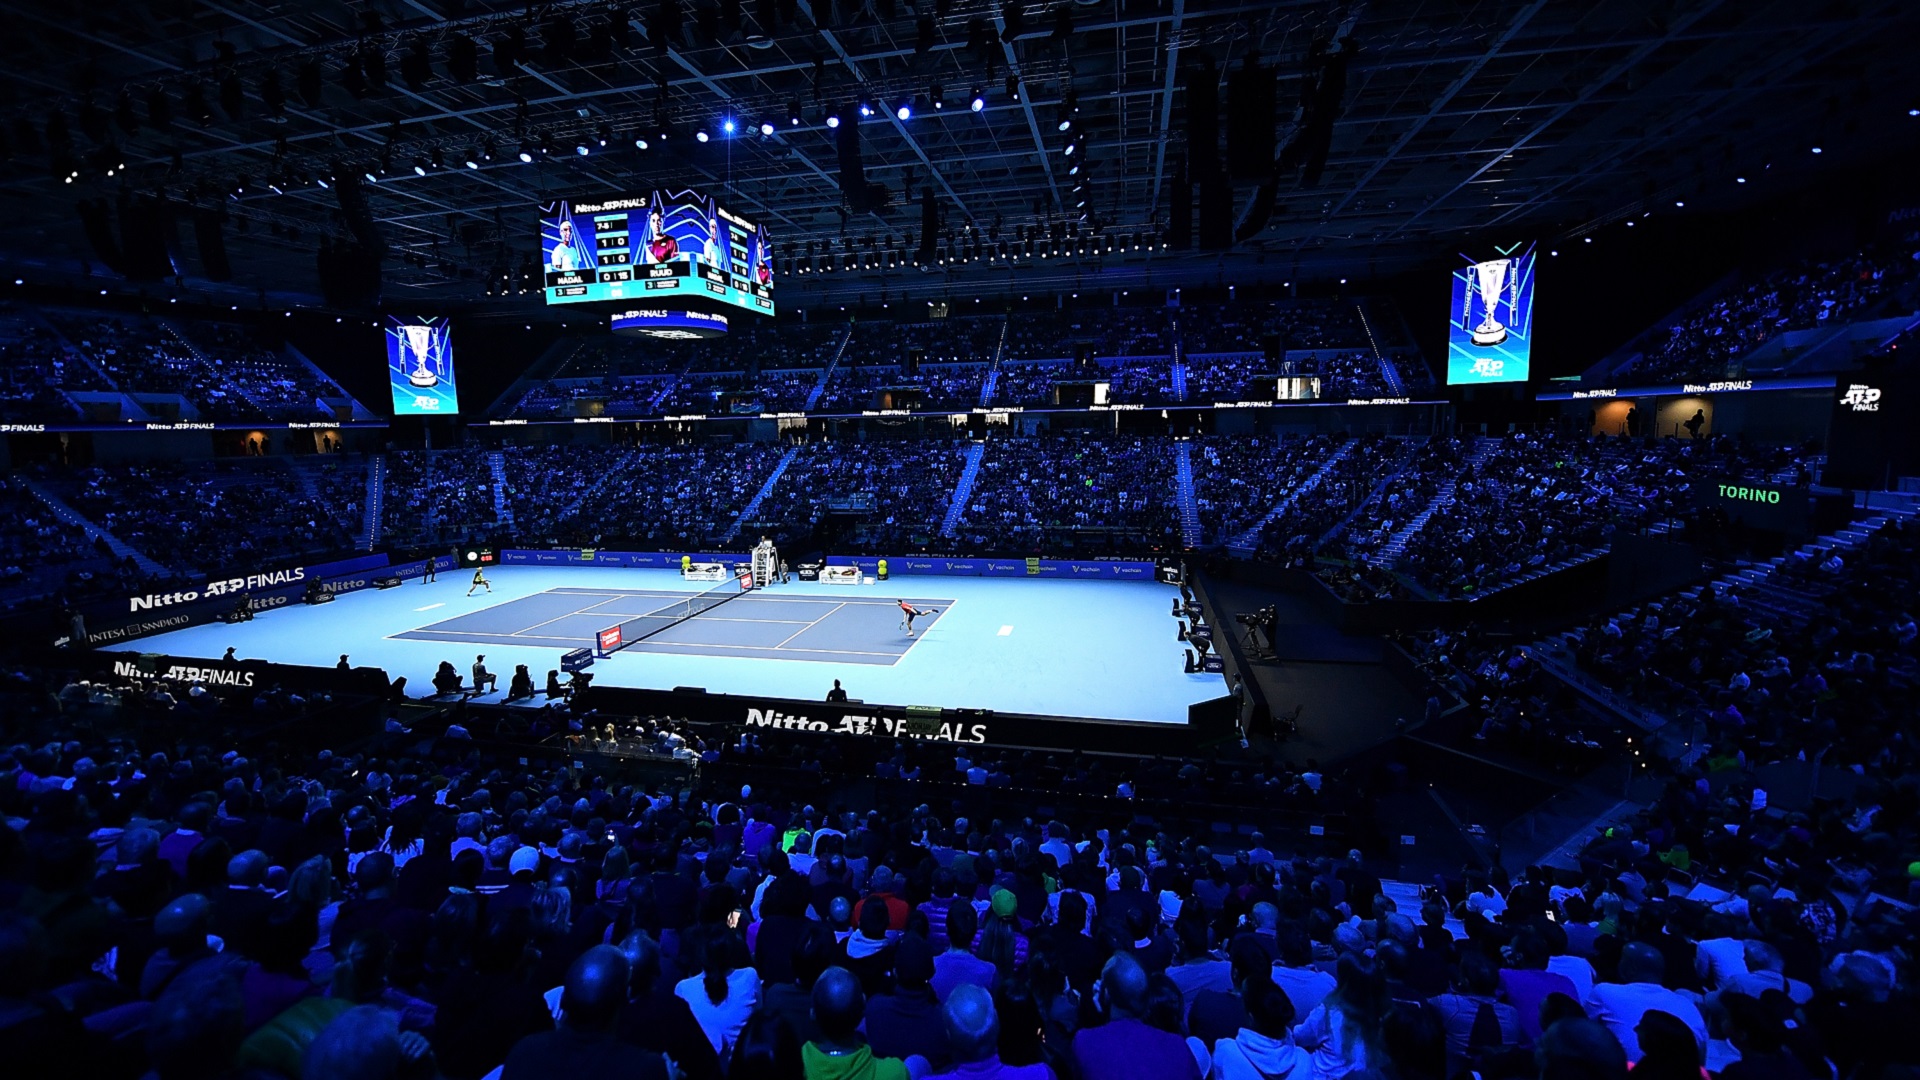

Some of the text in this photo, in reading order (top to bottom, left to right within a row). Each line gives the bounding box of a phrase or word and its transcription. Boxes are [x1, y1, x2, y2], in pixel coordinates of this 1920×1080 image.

[575, 204, 601, 213] Nitto
[619, 198, 646, 207] FINALS
[602, 238, 625, 247] 1 0
[603, 255, 625, 264] 1 0
[557, 275, 583, 284] NADAL
[604, 272, 628, 281] 0 15
[650, 269, 673, 277] RUUD
[639, 310, 667, 318] FINALS
[1683, 380, 1752, 393] Nitto ATP FINALS
[1839, 388, 1881, 405] ATP
[1718, 484, 1780, 504] TORINO
[130, 567, 305, 612] Nitto ATP FINALS
[323, 579, 366, 593] Nitto
[89, 629, 125, 643] INTESA
[199, 668, 254, 686] FINALS
[746, 708, 829, 732] Nitto
[894, 719, 987, 743] FALS
